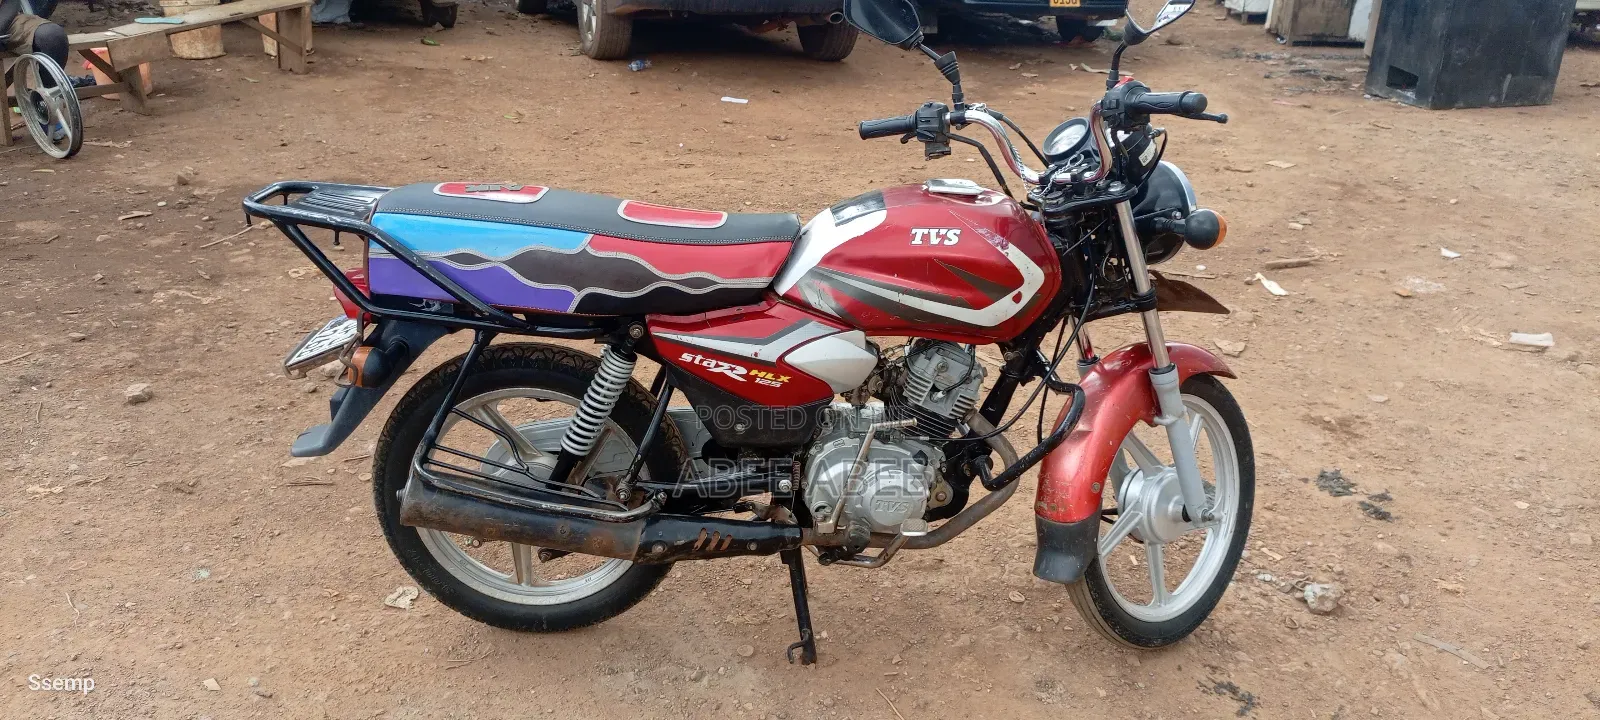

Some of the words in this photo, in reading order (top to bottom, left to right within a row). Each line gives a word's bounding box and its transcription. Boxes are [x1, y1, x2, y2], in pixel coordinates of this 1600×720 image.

[910, 227, 962, 246] TVS
[749, 369, 792, 383] HLX
[755, 378, 785, 388] 125
[875, 499, 910, 513] TVS
